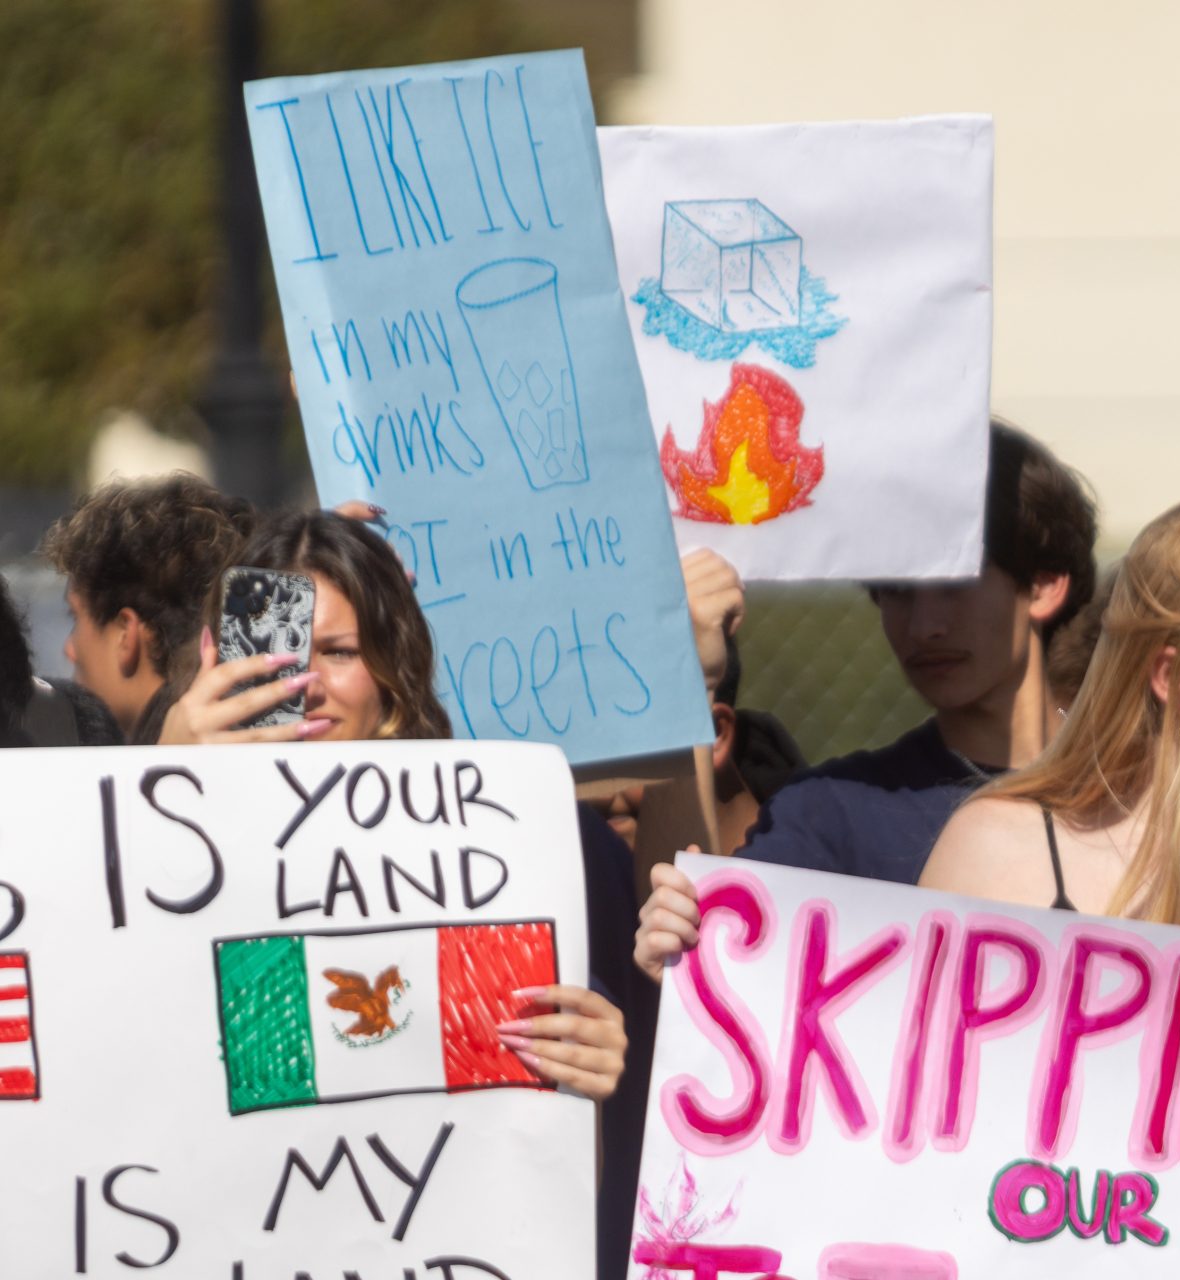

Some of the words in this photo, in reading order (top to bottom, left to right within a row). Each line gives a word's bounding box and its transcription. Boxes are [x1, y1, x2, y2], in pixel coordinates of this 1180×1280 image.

[255, 97, 339, 264] I
[325, 78, 455, 257] LIKE
[442, 65, 565, 233] ICE
[302, 316, 373, 385] in
[380, 309, 461, 394] my
[332, 392, 485, 489] drinks
[484, 523, 534, 581] in
[551, 506, 627, 572] the
[437, 608, 652, 740] reets
[98, 764, 226, 930] IS
[273, 758, 520, 850] YOUR
[275, 847, 510, 919] LAND
[74, 1162, 182, 1275] IS
[262, 1121, 456, 1242] MY
[987, 1157, 1170, 1245] OUR
